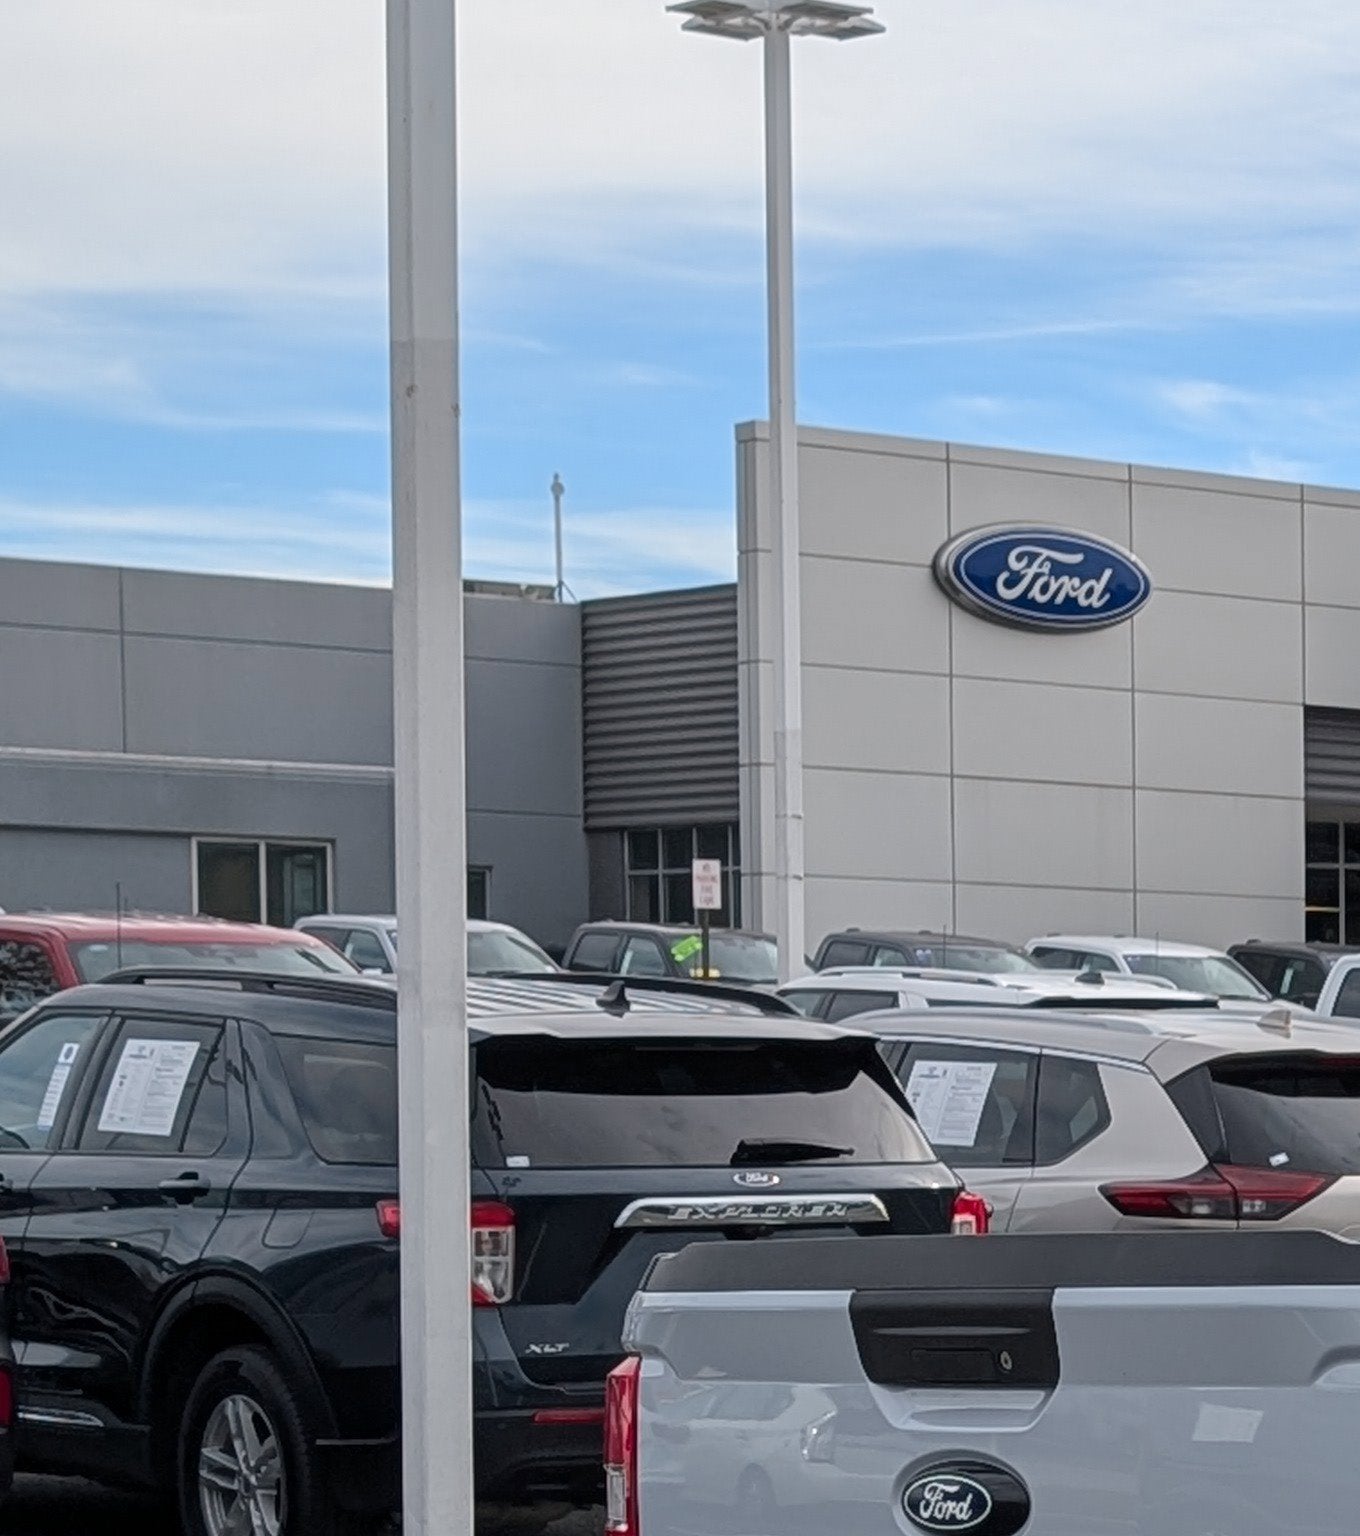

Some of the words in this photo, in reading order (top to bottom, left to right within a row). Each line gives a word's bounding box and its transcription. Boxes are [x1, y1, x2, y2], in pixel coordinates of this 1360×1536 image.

[996, 545, 1113, 609] Ford
[667, 1204, 848, 1220] EXPLORER
[525, 1342, 570, 1354] XLT
[919, 1482, 973, 1520] Ford
